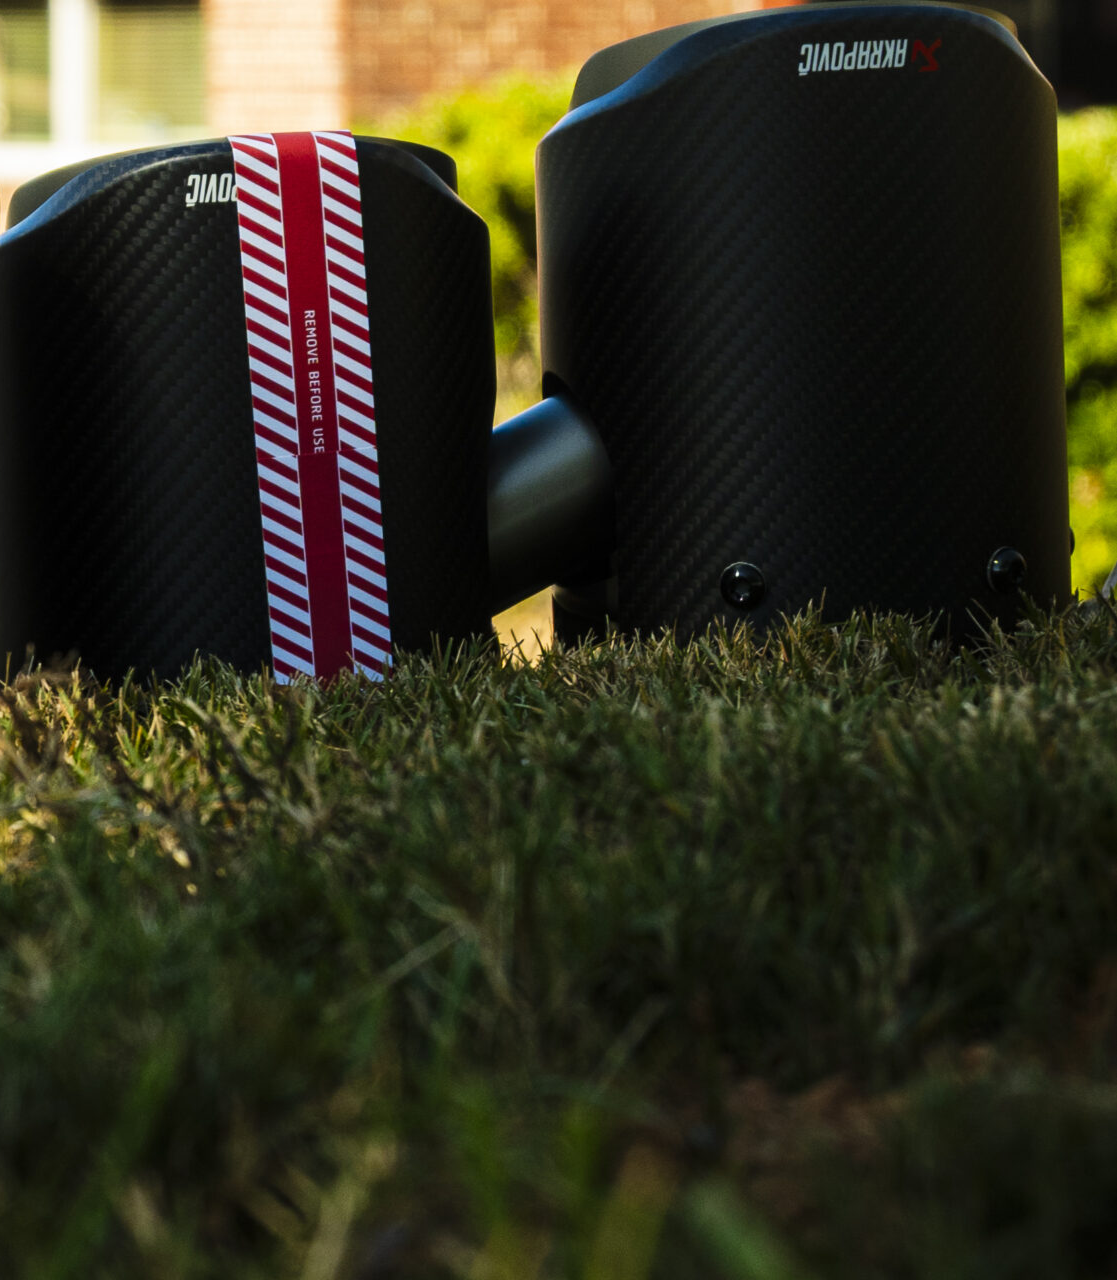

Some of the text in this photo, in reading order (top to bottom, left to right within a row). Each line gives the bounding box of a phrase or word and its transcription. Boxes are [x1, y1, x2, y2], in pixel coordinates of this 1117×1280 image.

[304, 309, 325, 454] REMOVE BEFORE USE
